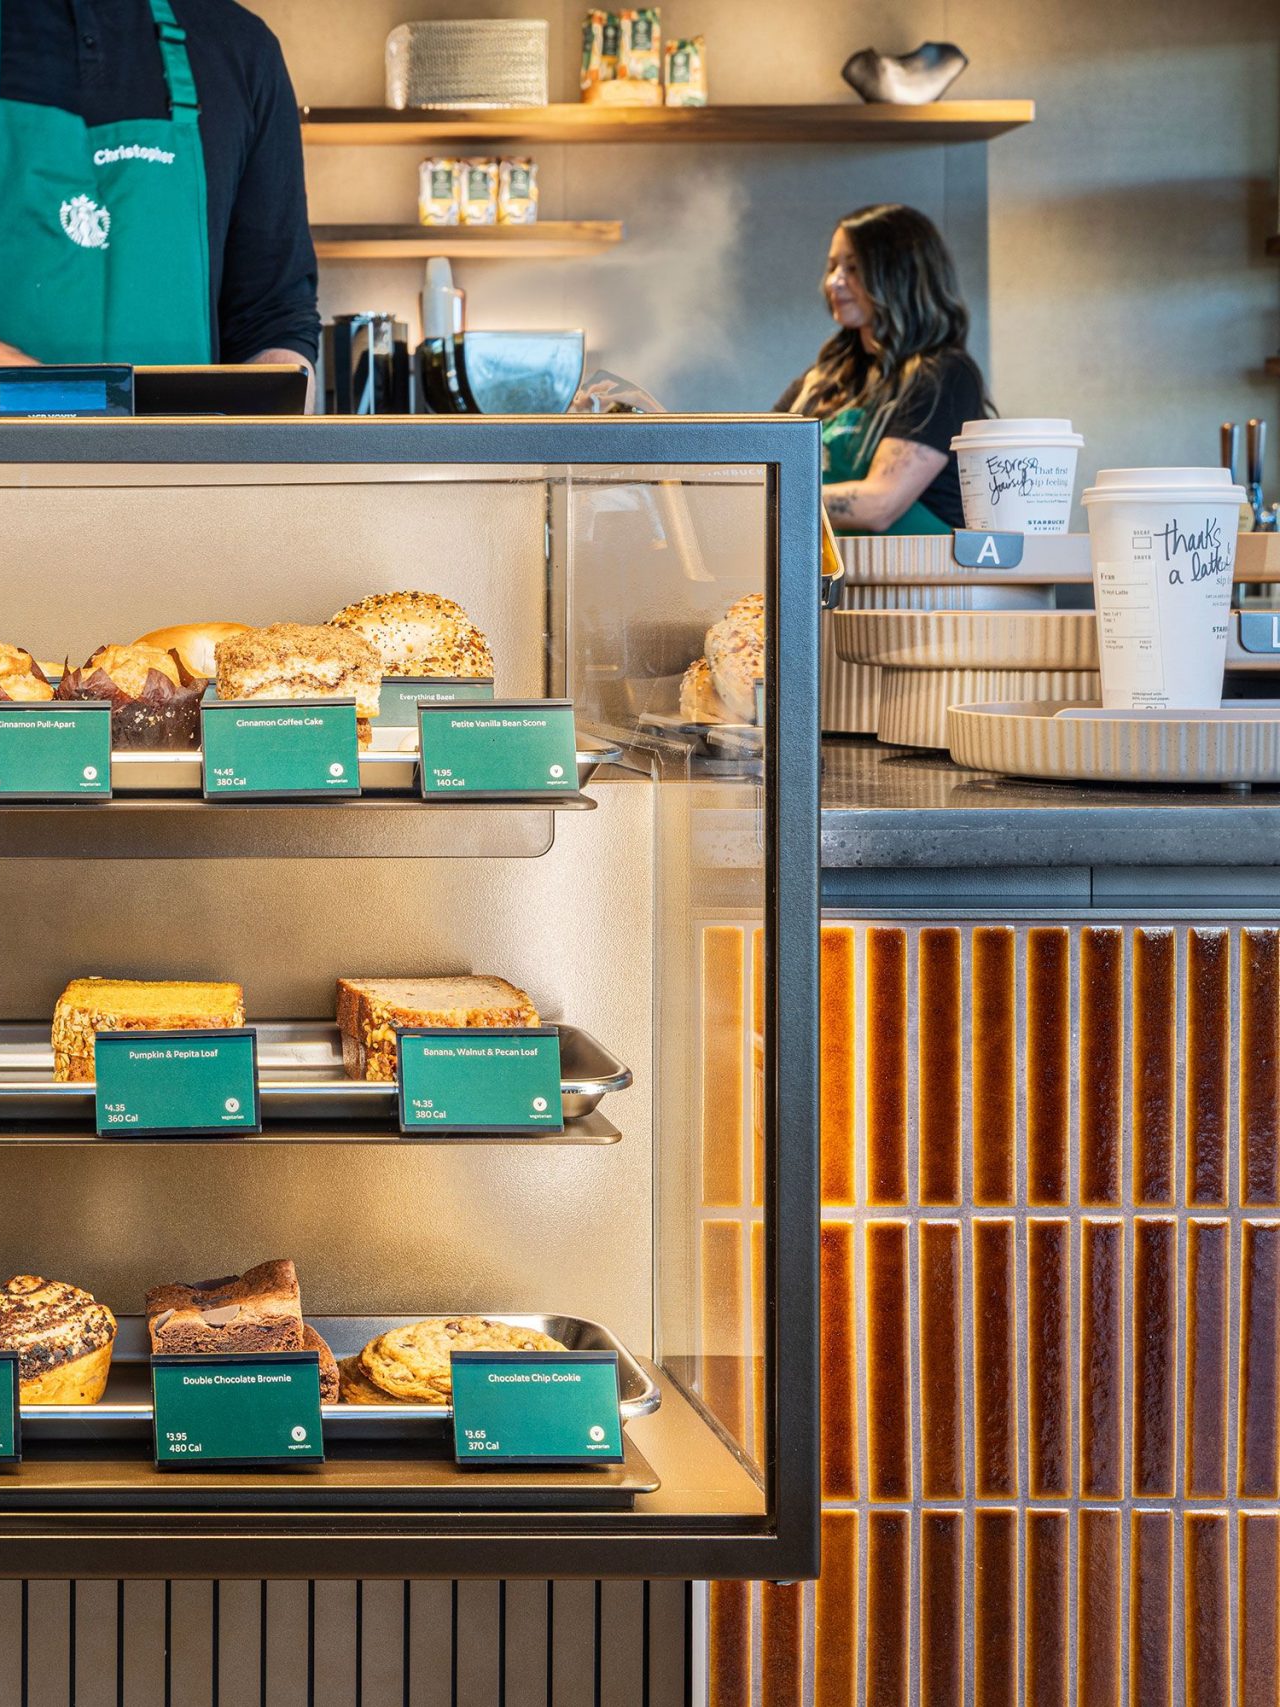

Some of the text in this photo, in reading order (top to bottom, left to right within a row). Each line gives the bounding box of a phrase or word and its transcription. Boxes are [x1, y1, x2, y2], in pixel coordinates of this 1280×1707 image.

[94, 144, 175, 165] Christopher
[1055, 467, 1068, 475] first
[976, 536, 1000, 564] A
[1169, 569, 1184, 584] a
[37, 721, 75, 729] Pull-Apart
[277, 718, 303, 726] Coffee
[451, 720, 474, 728] Petite
[130, 1049, 218, 1060] Pumpkin & Pepita Loaf
[424, 1048, 455, 1056] Banana,
[457, 1048, 486, 1056] Walnut
[495, 1048, 519, 1056] Pecan
[521, 1048, 538, 1056] Loaf
[105, 1104, 125, 1112] $4.35
[413, 1100, 433, 1108] $4.35
[108, 1114, 138, 1122] 360 Cal
[184, 1374, 291, 1384] Double Chocolate Brownie
[488, 1374, 581, 1383] Chocolate Chip Cookie
[167, 1433, 187, 1441] $3.95
[465, 1430, 486, 1439] $3.65
[170, 1444, 201, 1452] 480 Cal
[469, 1442, 499, 1450] 370 Cal
